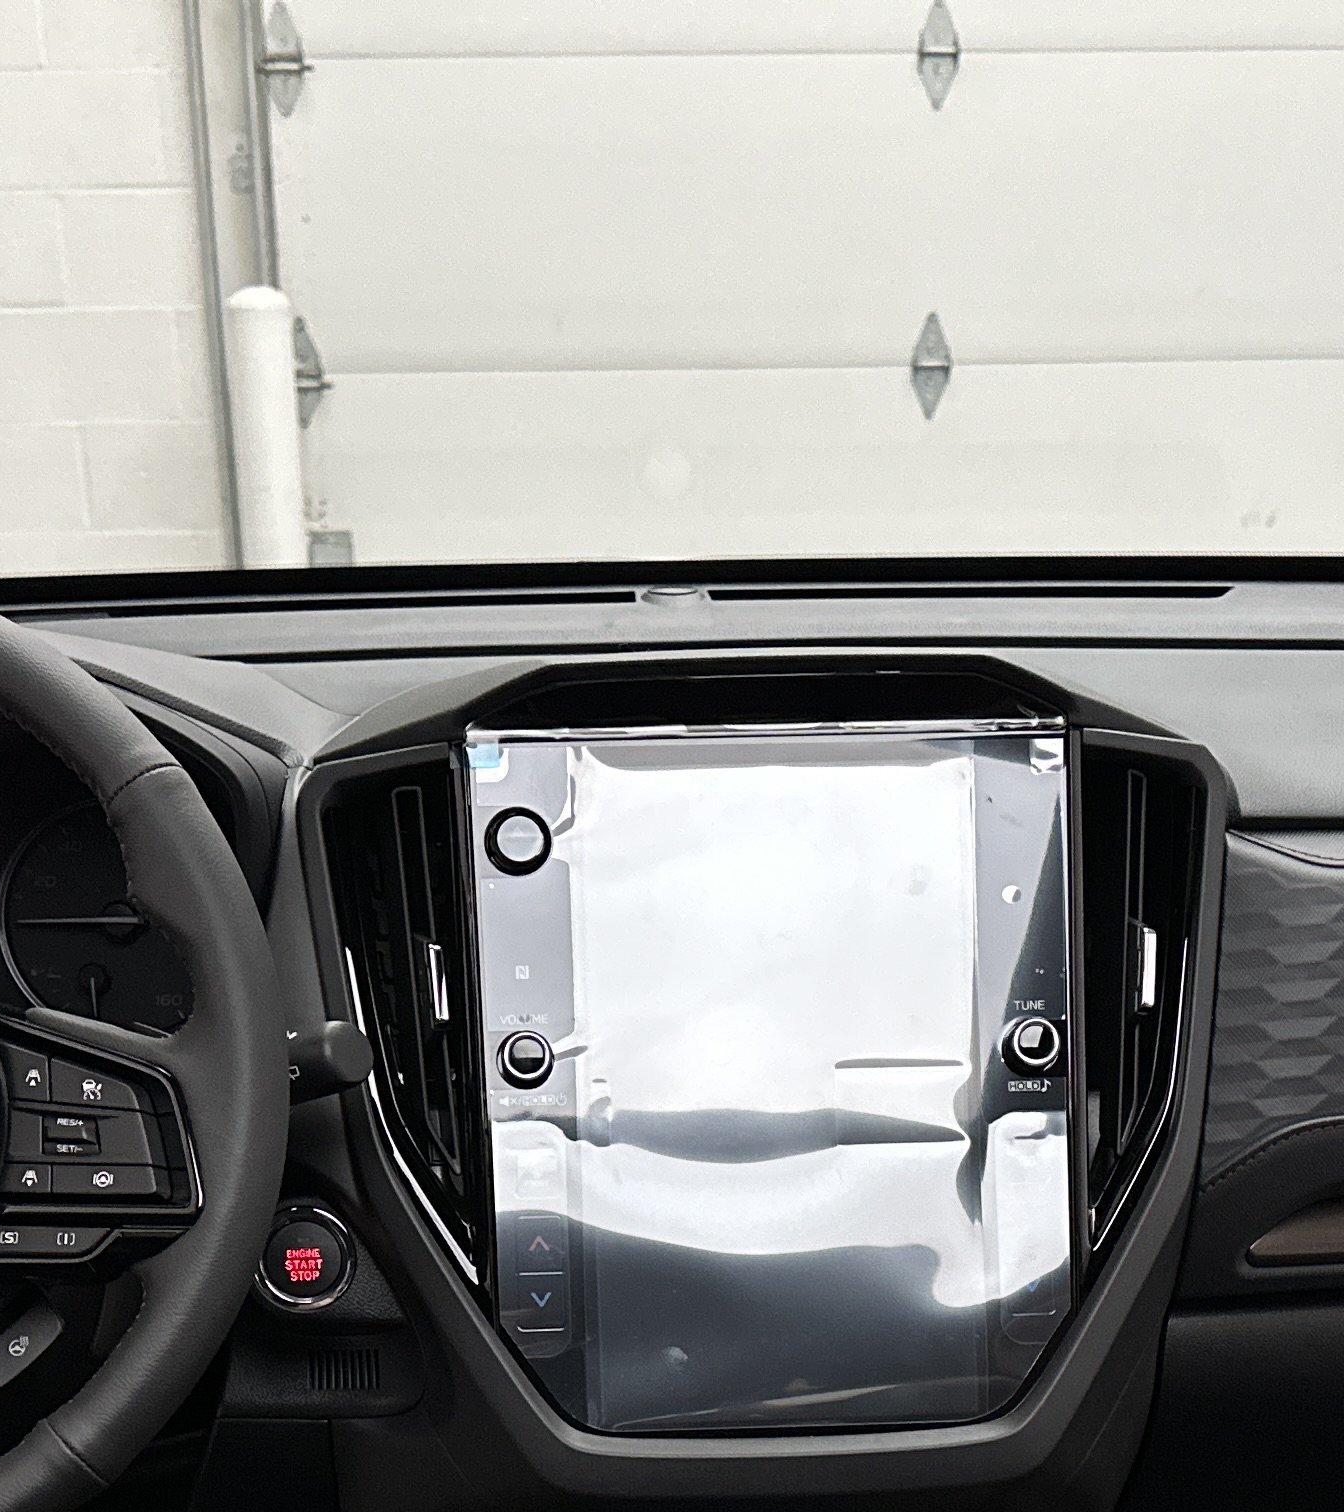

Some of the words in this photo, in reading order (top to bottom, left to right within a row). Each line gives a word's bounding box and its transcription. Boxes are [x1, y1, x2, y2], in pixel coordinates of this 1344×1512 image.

[154, 993, 184, 1007] 160
[1014, 999, 1046, 1011] TUNE
[500, 1013, 549, 1026] VOLUME
[1008, 1080, 1041, 1093] HOLD
[286, 1248, 320, 1259] ENGINE
[284, 1258, 323, 1270] START
[290, 1270, 320, 1281] STOP
